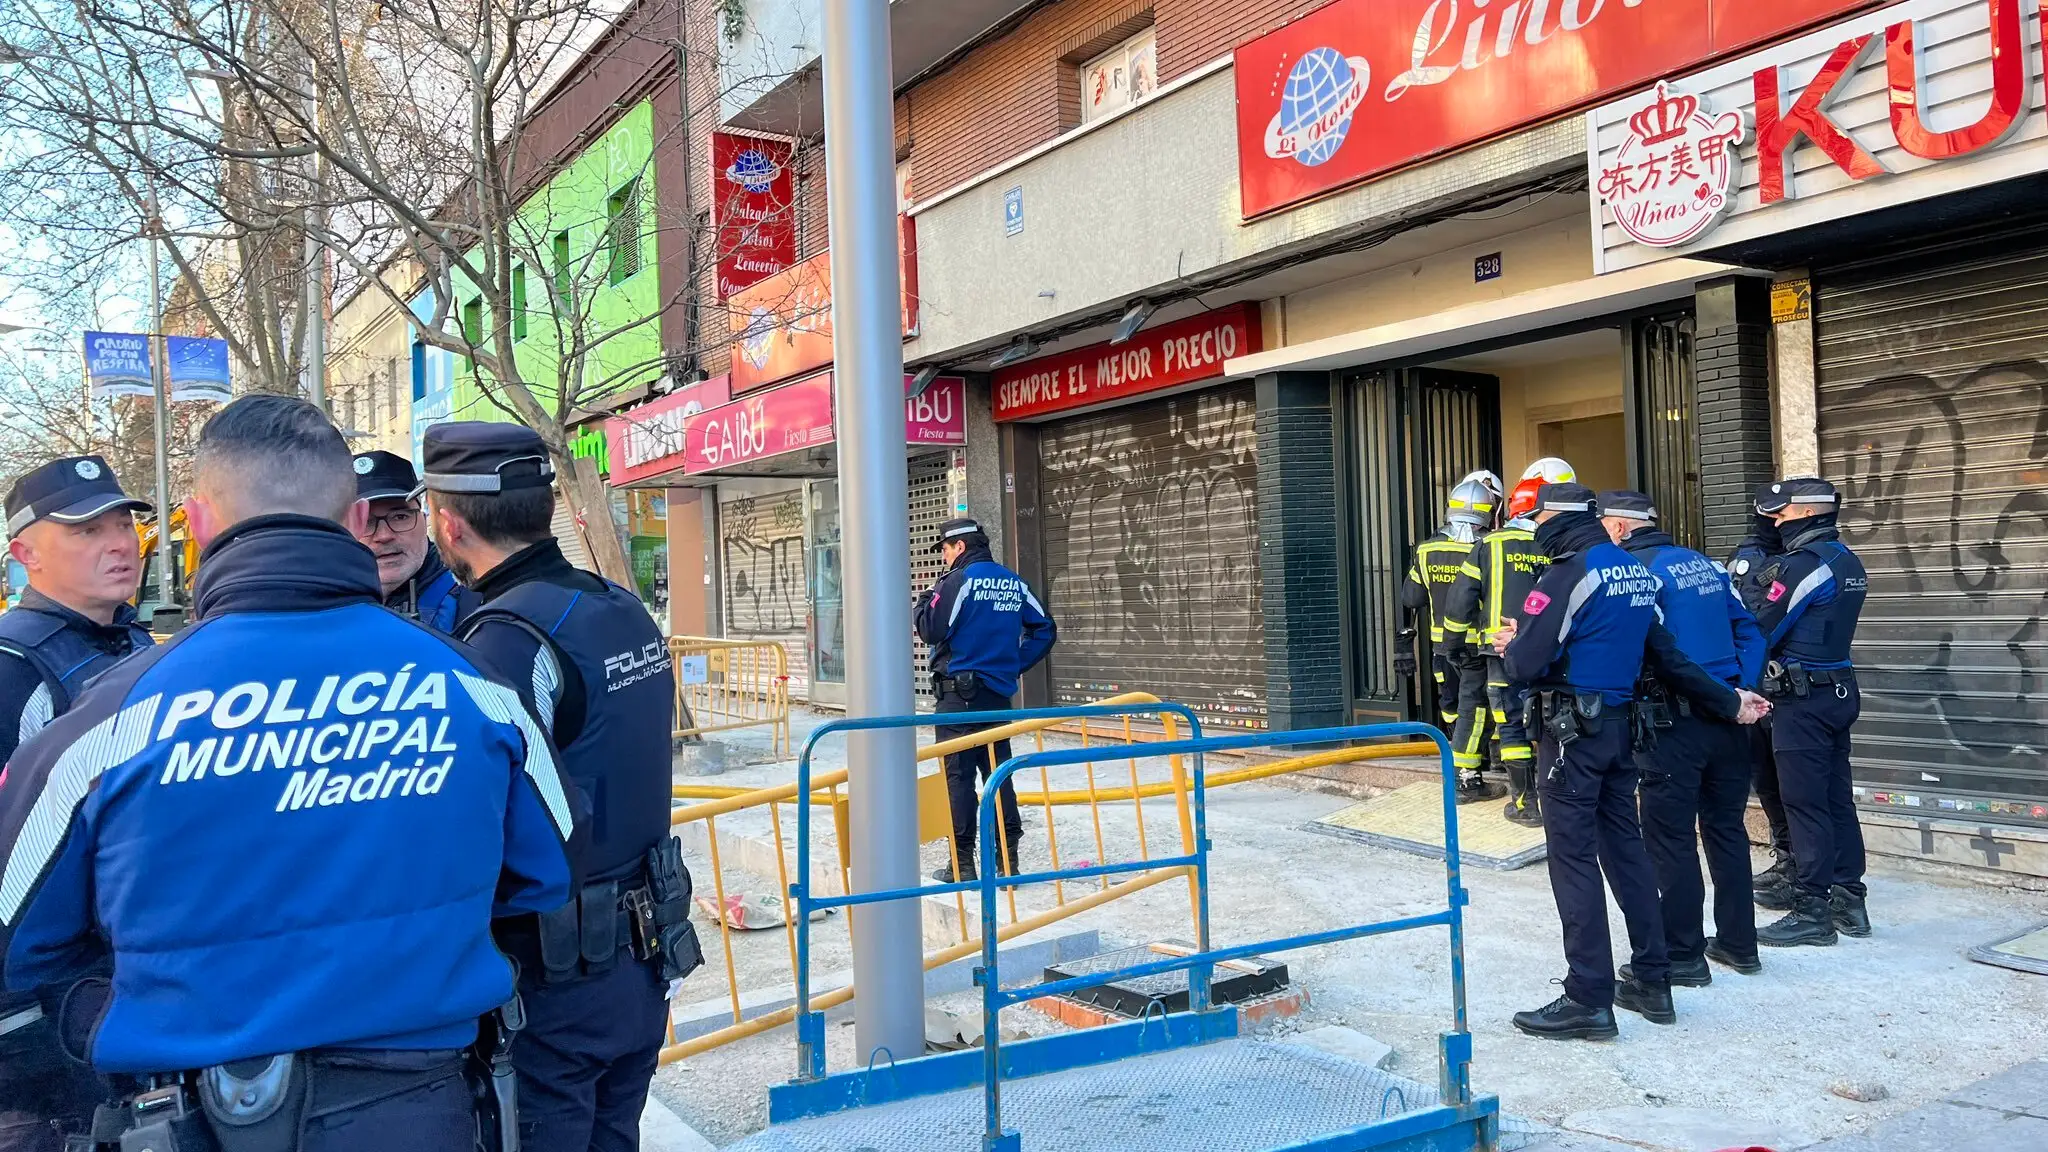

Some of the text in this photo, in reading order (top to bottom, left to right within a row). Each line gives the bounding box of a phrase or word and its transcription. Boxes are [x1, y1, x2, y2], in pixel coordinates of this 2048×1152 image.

[1753, 0, 2048, 204] KU
[1627, 200, 1690, 229] Uñas
[1476, 258, 1499, 277] 328
[94, 337, 143, 350] MADRID
[121, 349, 138, 359] FIN
[92, 358, 146, 373] RESPIRA
[1000, 324, 1236, 411] SIEMPRE EL MEJOR PRECIO
[783, 428, 808, 450] Fiesta
[918, 428, 944, 440] Fiesta
[1601, 563, 1650, 583] POLICÍA
[1666, 556, 1712, 578] POLICÍA
[973, 577, 1020, 591] POLICÍA
[1606, 579, 1657, 597] MUNICIPAL
[1675, 570, 1719, 590] MUNICIPAL
[1697, 583, 1723, 596] Madrid
[974, 590, 1022, 602] MUNICIPAL
[1630, 593, 1656, 607] Madrid
[993, 601, 1021, 612] Madrid
[157, 663, 447, 742] POLICÍA
[160, 716, 457, 785] MUNICIPAL
[275, 756, 454, 812] Madrid
